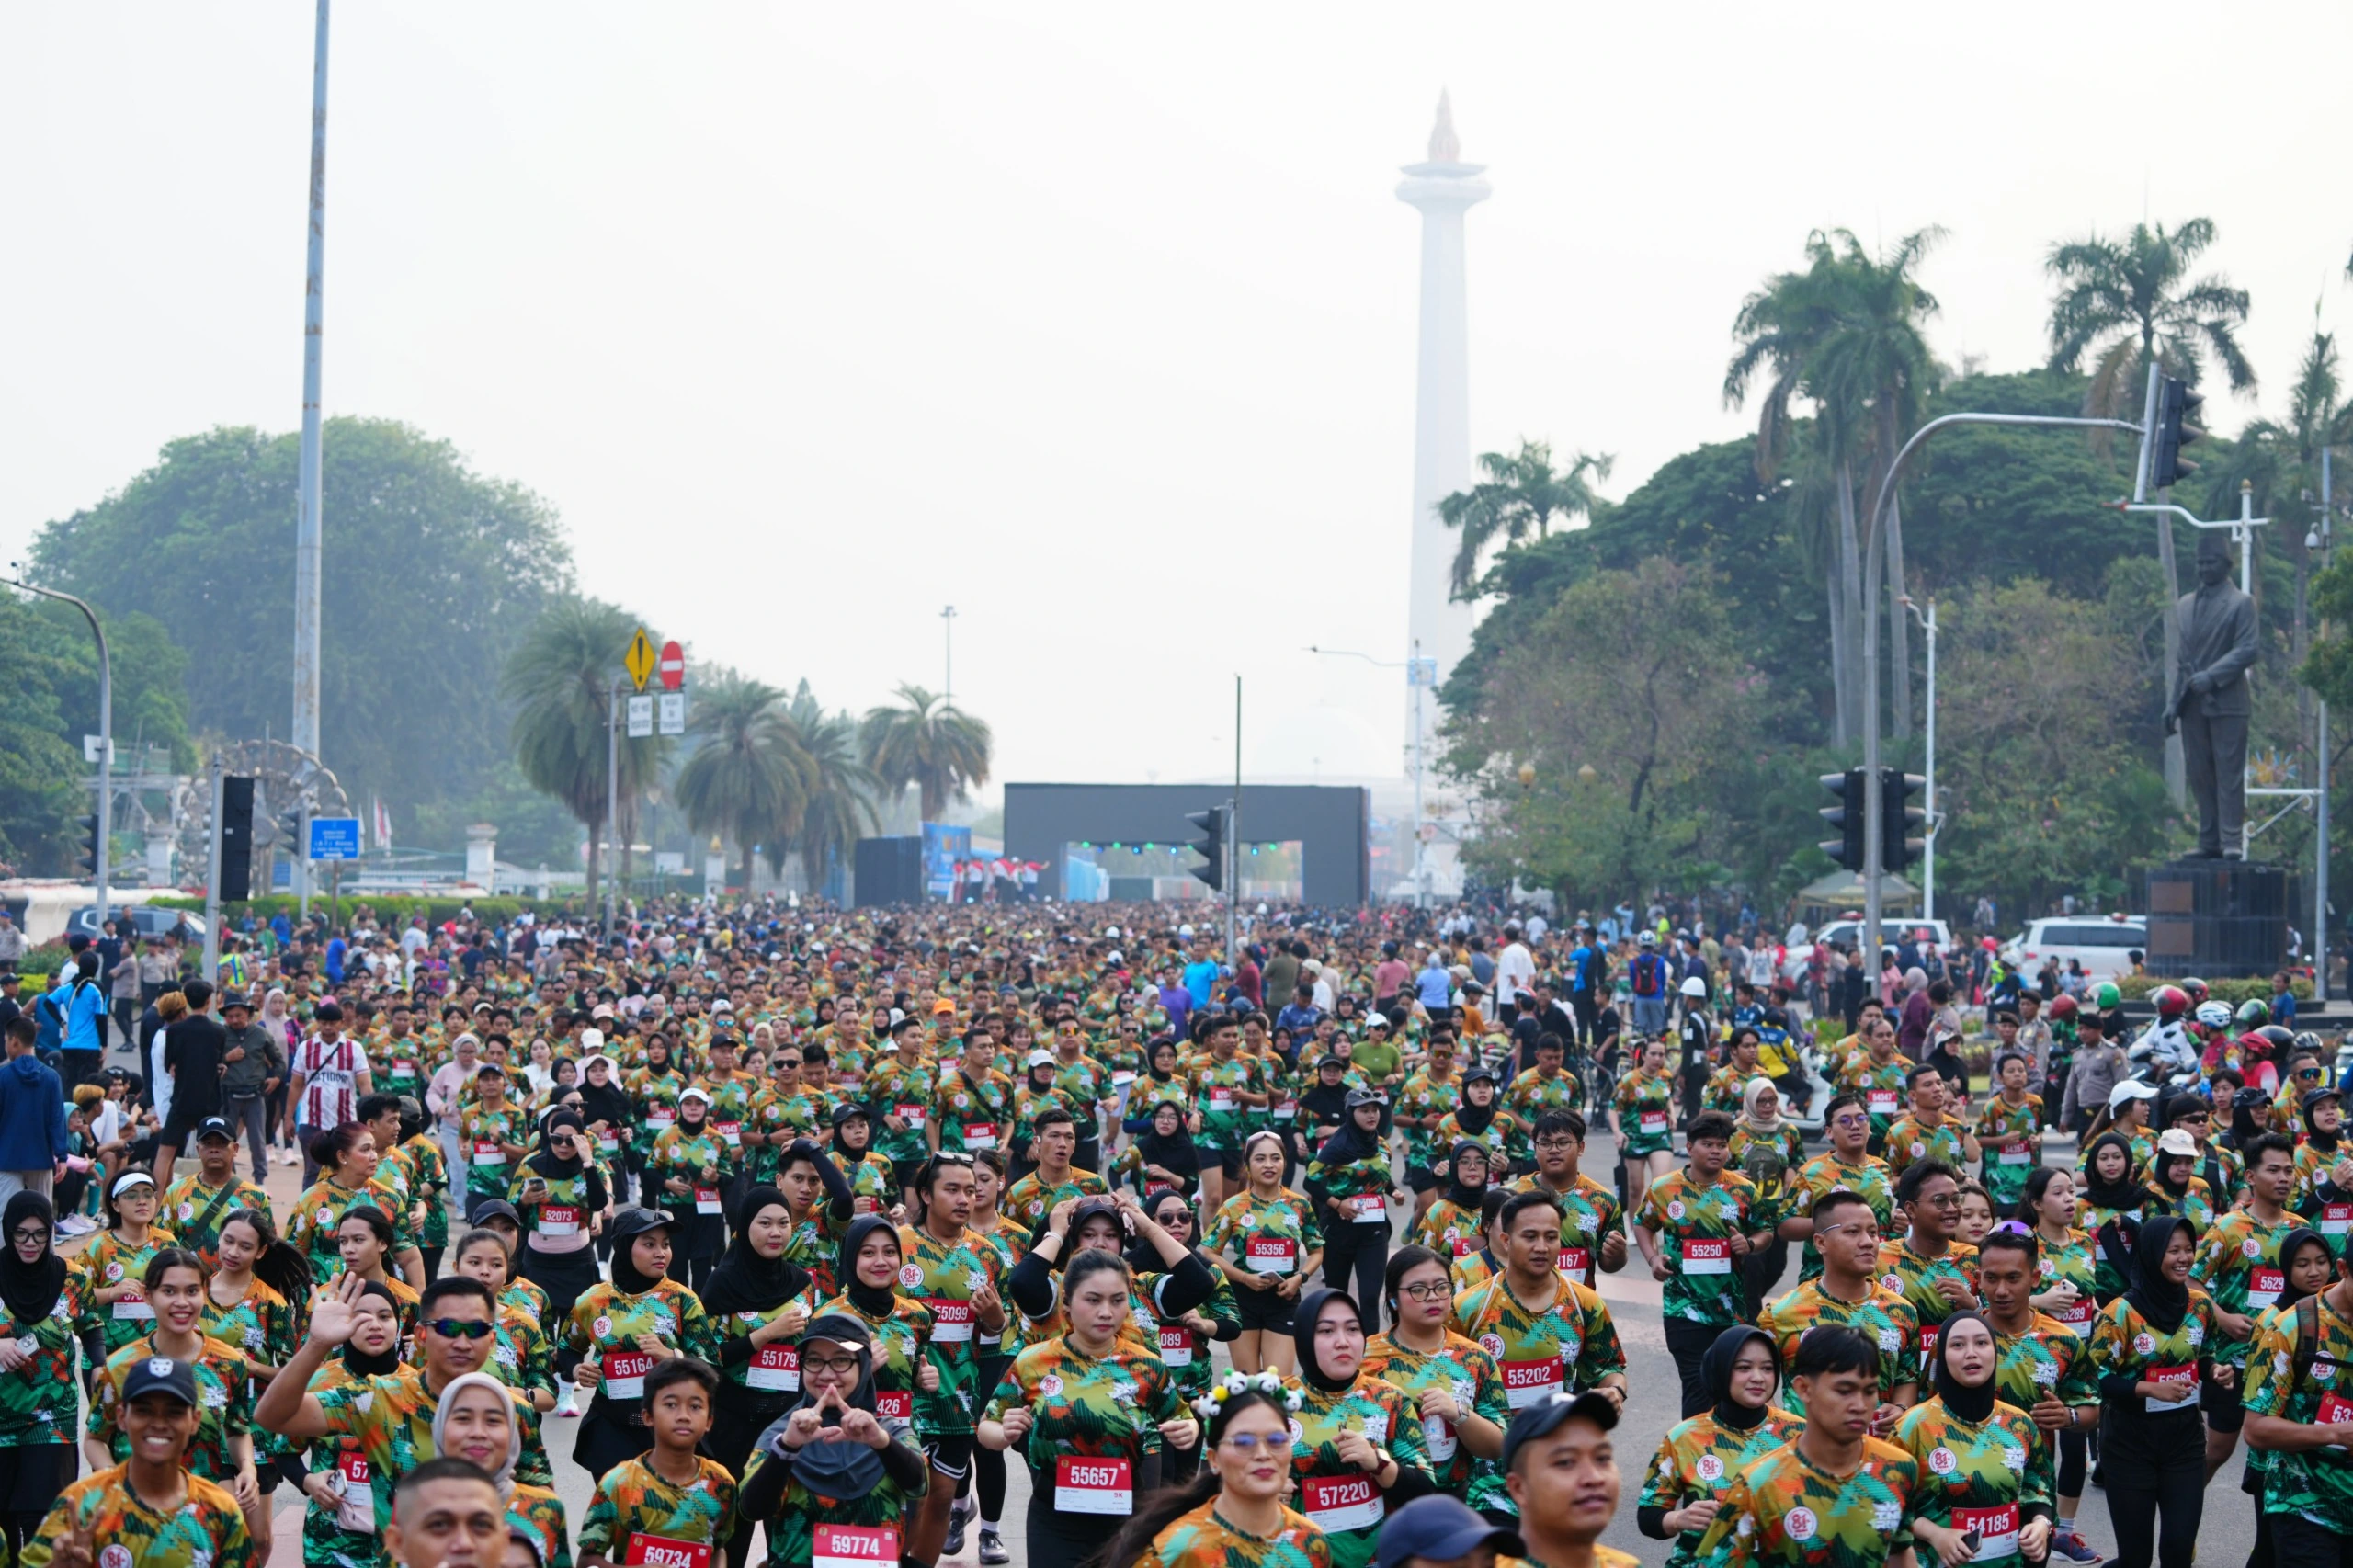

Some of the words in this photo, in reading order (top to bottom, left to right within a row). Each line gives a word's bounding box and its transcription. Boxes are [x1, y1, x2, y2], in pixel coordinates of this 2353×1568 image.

[546, 1210, 572, 1221] 52073
[1256, 1244, 1285, 1256] 55356
[1691, 1244, 1722, 1257] 55250
[2260, 1276, 2284, 1290] 5629
[614, 1357, 654, 1376] 55164
[762, 1350, 798, 1368] 55179
[1507, 1365, 1551, 1385] 55202
[1070, 1465, 1118, 1486] 55657
[1318, 1480, 1370, 1507] 57220
[1369, 1500, 1377, 1508] 5K
[1966, 1512, 2010, 1533] 54185
[831, 1534, 880, 1555] 59774
[644, 1546, 691, 1568] 59734
